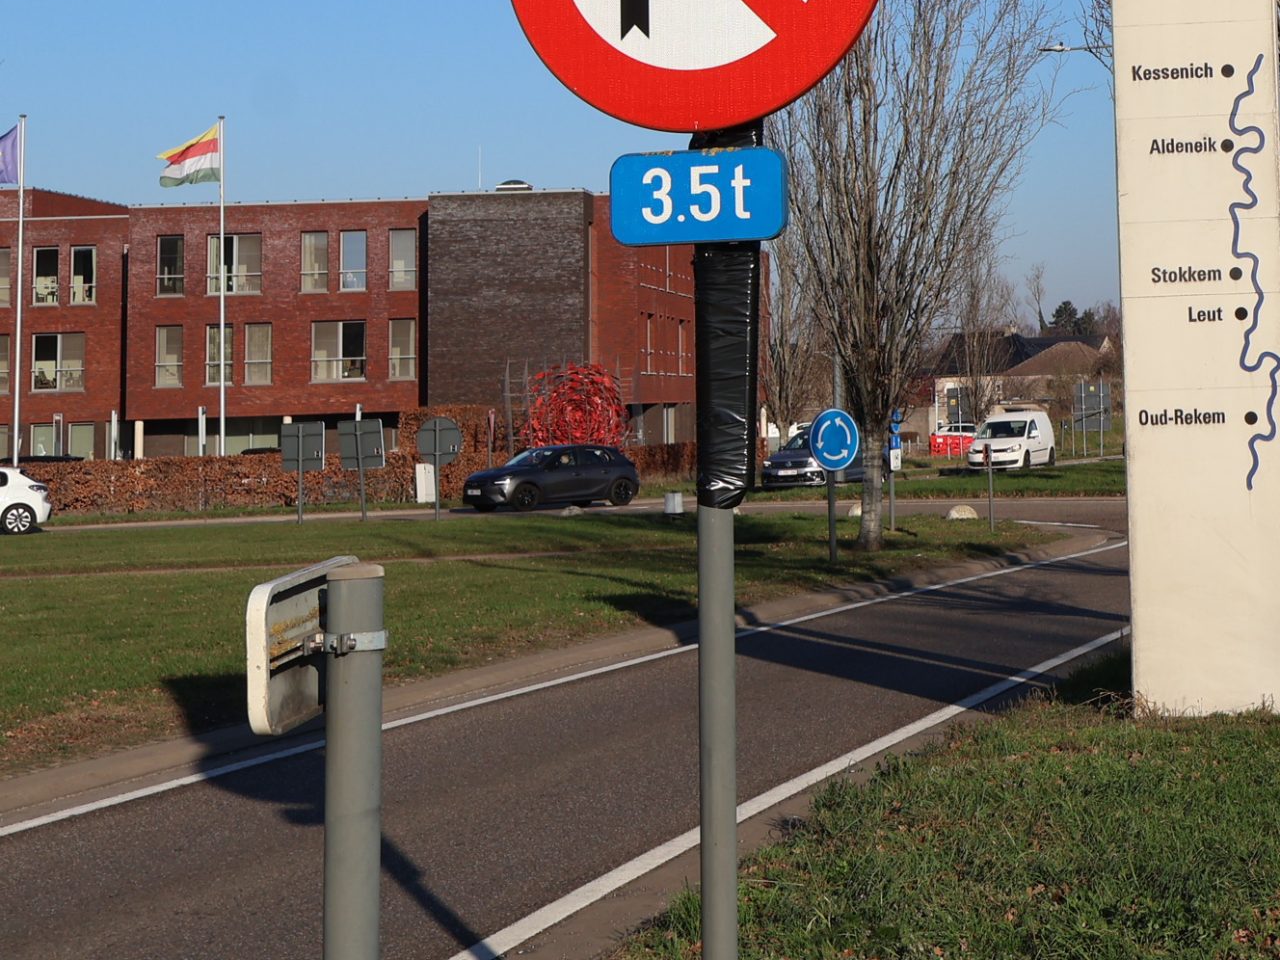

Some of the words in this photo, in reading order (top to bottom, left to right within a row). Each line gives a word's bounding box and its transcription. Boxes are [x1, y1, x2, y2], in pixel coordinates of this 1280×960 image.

[1131, 63, 1214, 82] Kessenich
[1149, 137, 1217, 155] Aldeneik
[1151, 266, 1222, 284] Stokkem
[1188, 306, 1223, 323] Leut
[1138, 408, 1226, 426] Oud-Rekem
